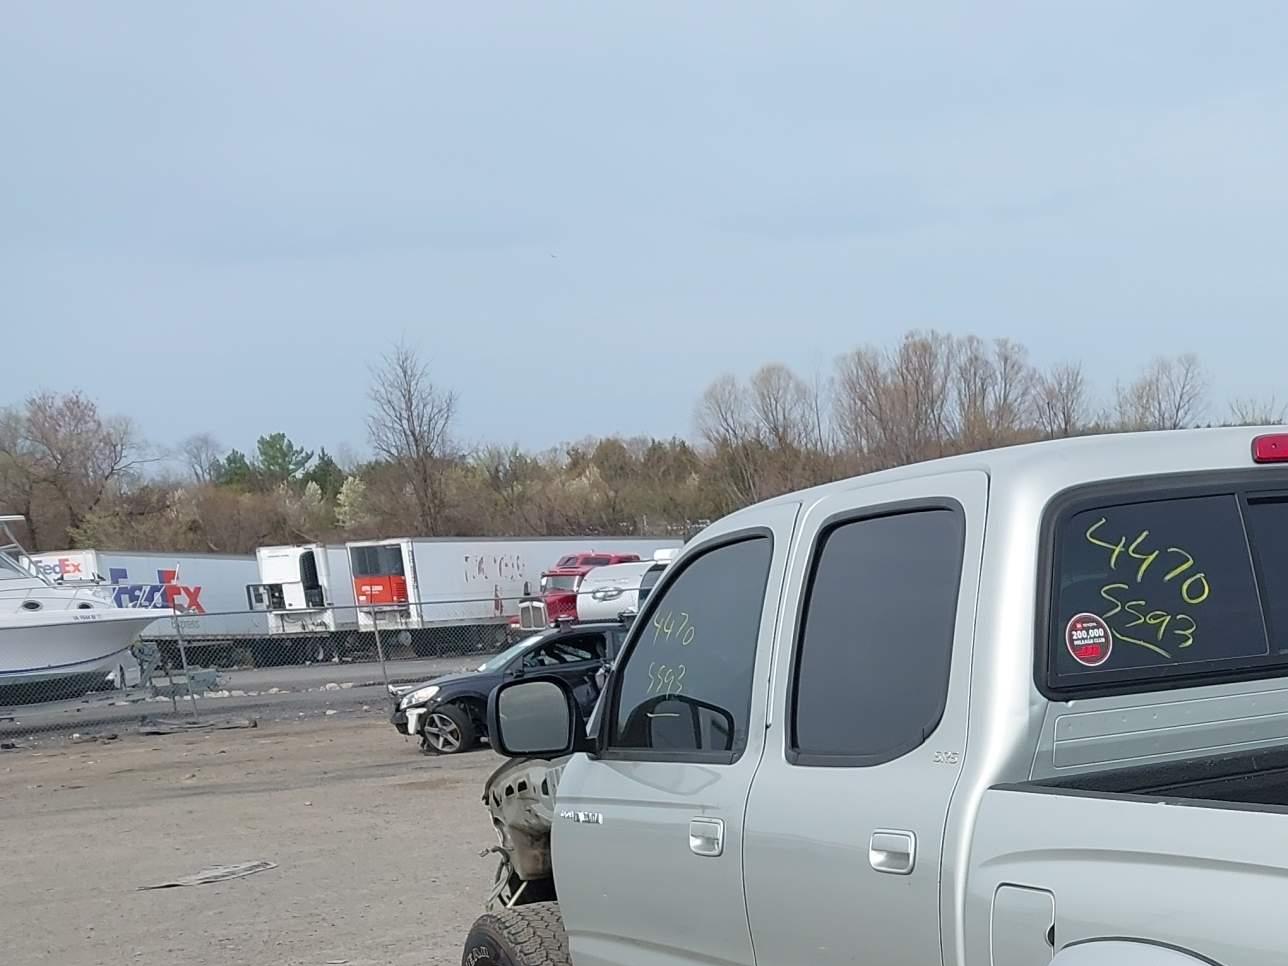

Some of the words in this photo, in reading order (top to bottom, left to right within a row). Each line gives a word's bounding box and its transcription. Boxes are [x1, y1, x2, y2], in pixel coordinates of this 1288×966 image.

[1086, 517, 1209, 604] 4470
[653, 610, 695, 647] 4470
[1071, 627, 1105, 640] 200,000
[1100, 583, 1197, 648] 5593
[647, 661, 686, 700] 5593
